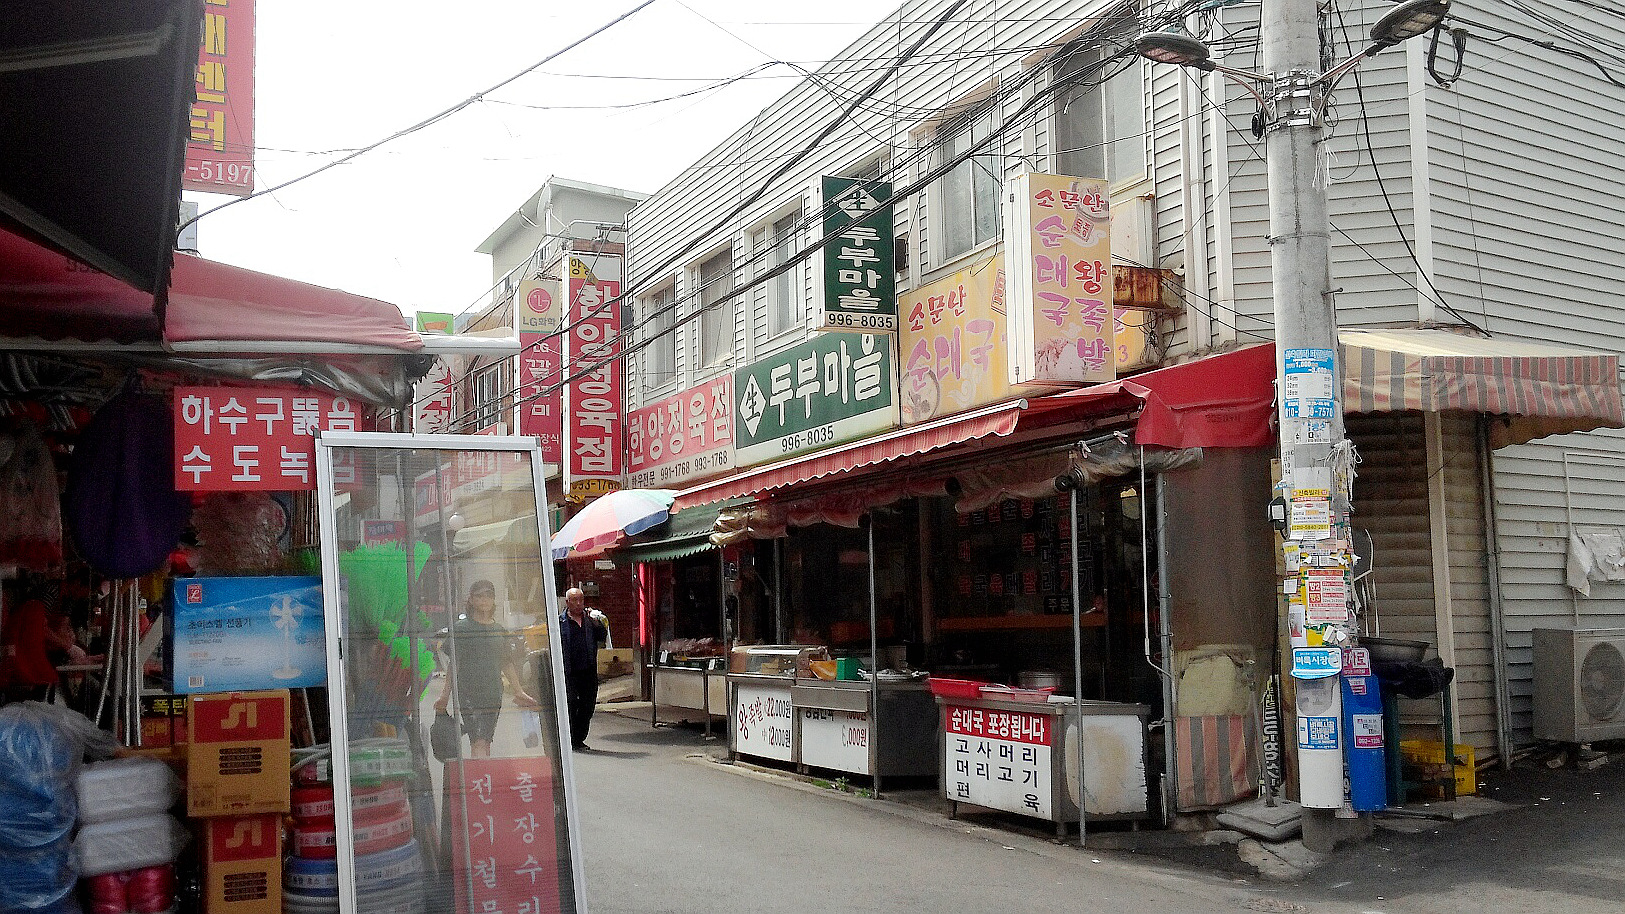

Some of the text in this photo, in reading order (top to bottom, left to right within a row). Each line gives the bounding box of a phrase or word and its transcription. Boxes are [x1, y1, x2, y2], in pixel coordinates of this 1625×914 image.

[187, 160, 253, 185] -5197
[1034, 189, 1106, 215] 소문난
[838, 226, 883, 312] 두부마을
[1034, 215, 1071, 327] 순대국
[522, 316, 557, 328] LG화학
[827, 313, 894, 329] 996-8035
[908, 284, 967, 333] 소문난
[1073, 259, 1112, 372] 왕족발
[906, 318, 996, 393] 순대국
[574, 285, 620, 472] 한양정육점
[769, 333, 883, 427] 두부마을
[181, 395, 356, 436] 하수구뚫음
[628, 379, 732, 466] 한양정육점
[781, 425, 835, 453] 996-8035
[660, 463, 691, 482] 991-1768
[693, 450, 729, 472] 993-1768
[226, 617, 253, 629] 선풍기
[951, 709, 1046, 743] 순대국 포장됩니다
[955, 737, 1038, 767] 고사머리
[955, 758, 1039, 790] 머리고기
